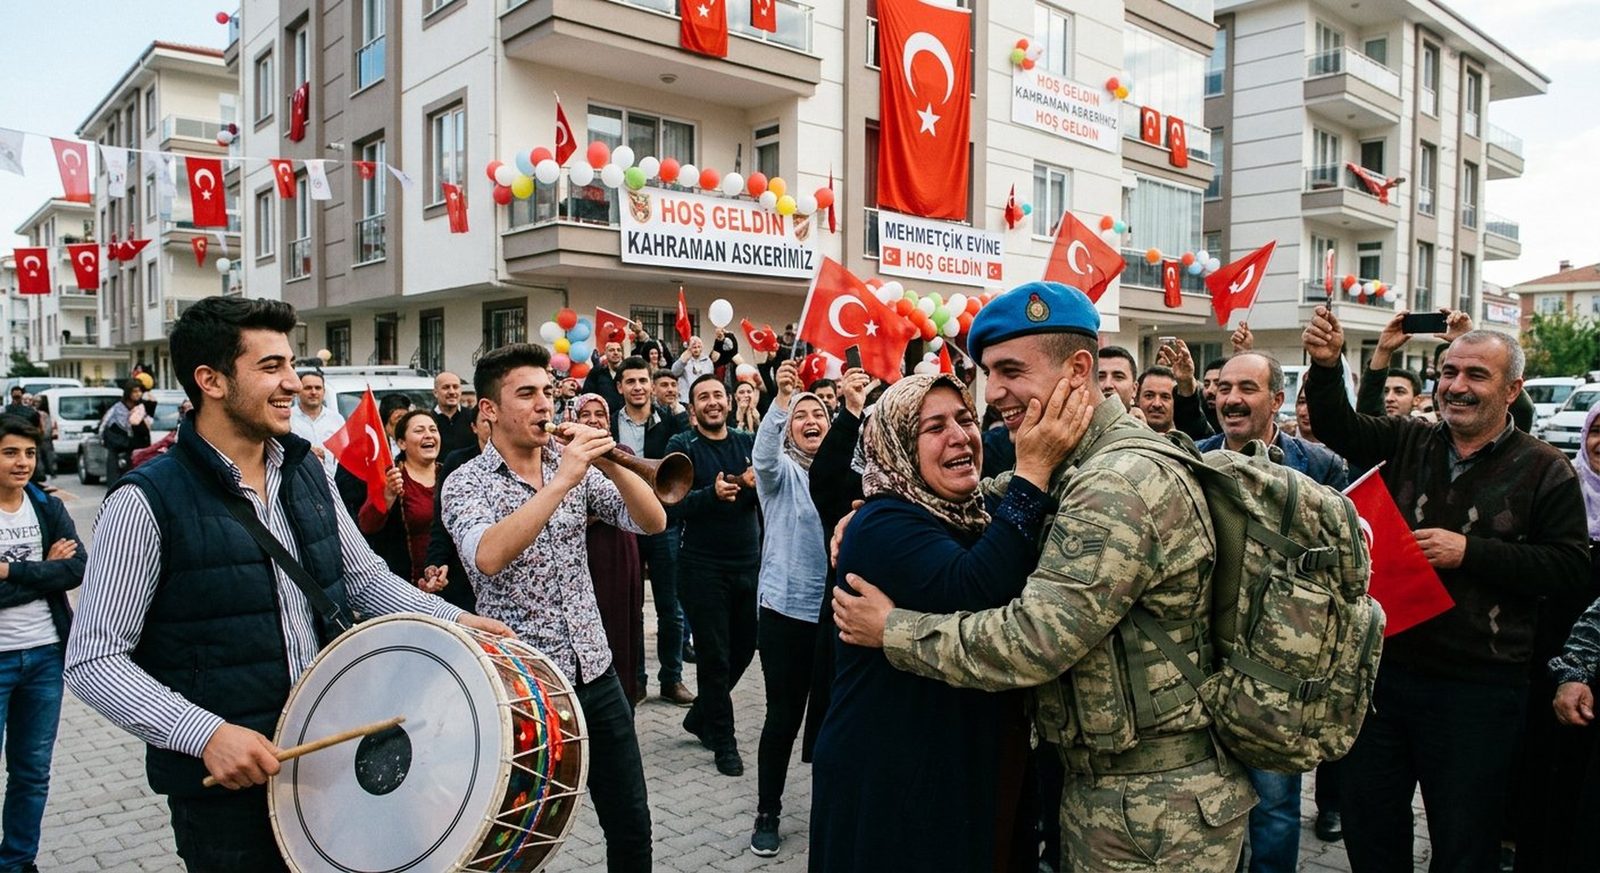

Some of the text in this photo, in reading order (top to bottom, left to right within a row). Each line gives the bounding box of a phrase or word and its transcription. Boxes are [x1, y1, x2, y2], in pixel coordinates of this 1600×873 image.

[1015, 86, 1070, 113] KAHRAMAN
[661, 198, 785, 236] HOŞ GELDİN
[628, 230, 813, 270] KAHRAMAN ASKERİMİZ
[885, 221, 1001, 256] MEHMETÇİK EVİNE
[907, 251, 982, 277] HOŞ GELDİN
